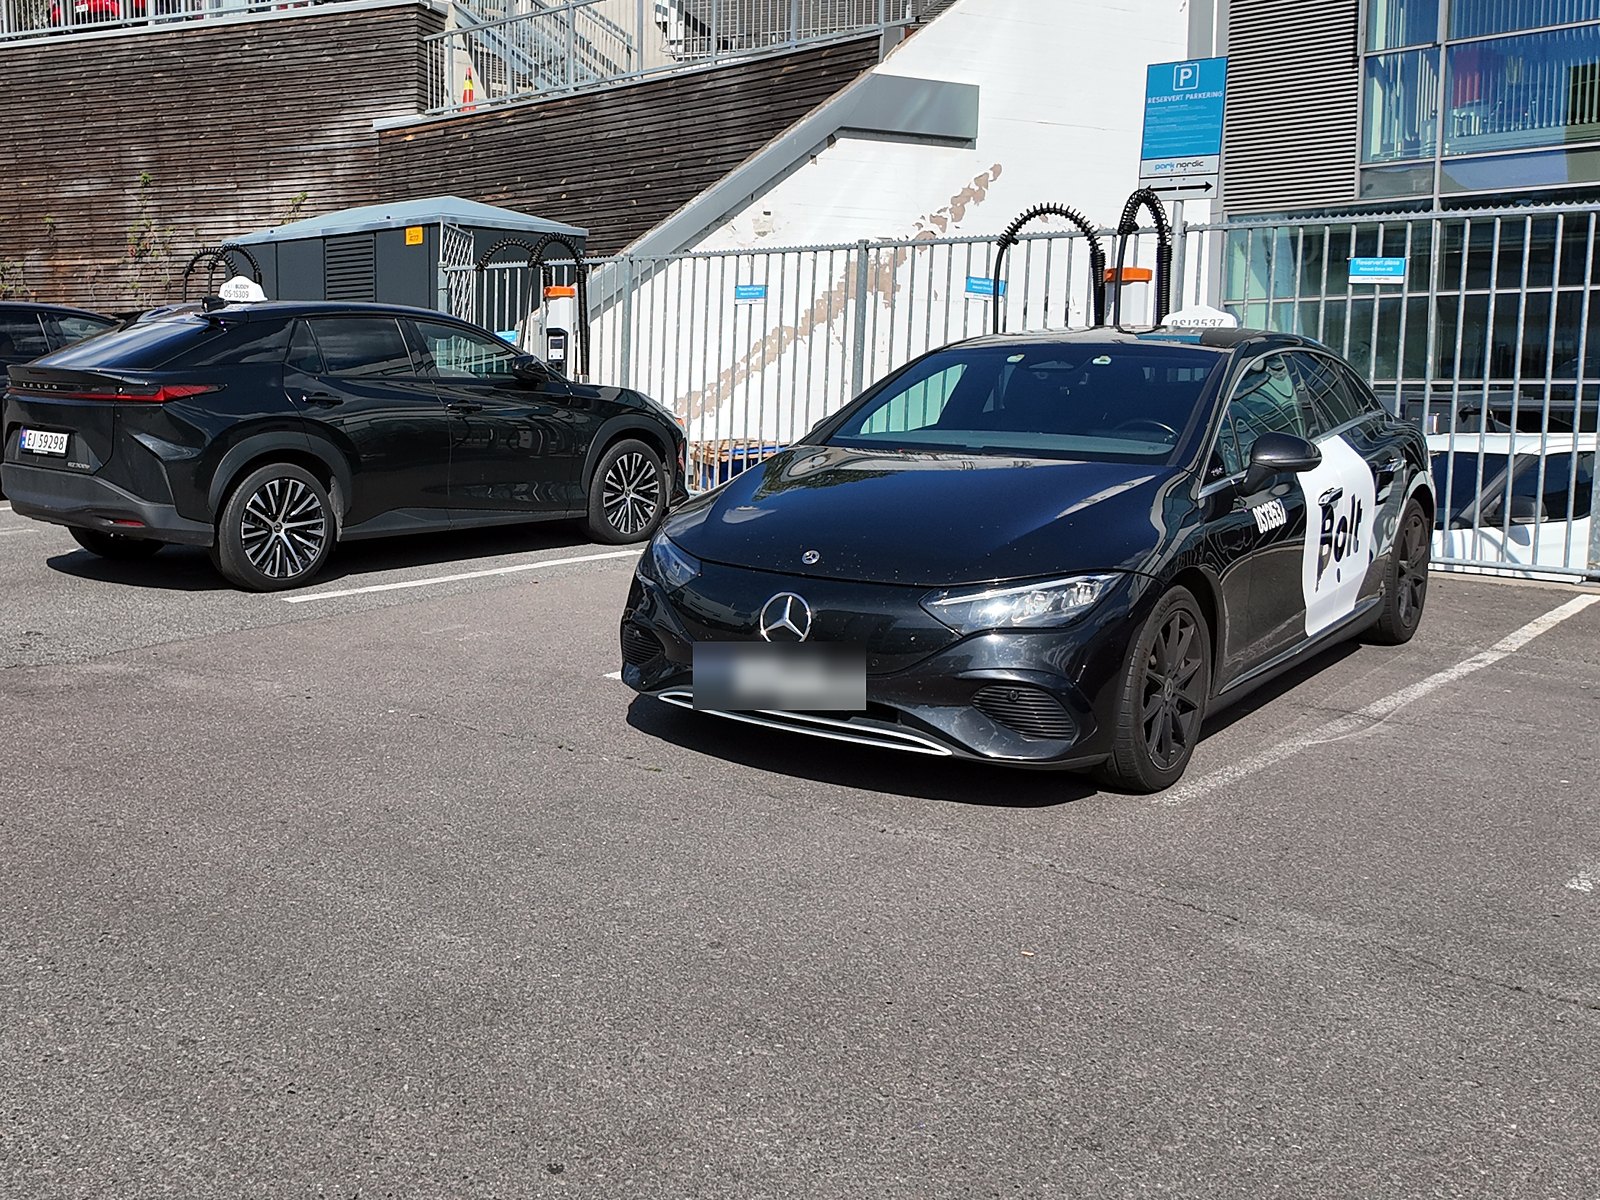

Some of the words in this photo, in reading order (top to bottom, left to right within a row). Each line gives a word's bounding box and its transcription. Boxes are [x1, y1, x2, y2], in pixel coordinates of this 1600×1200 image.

[1179, 68, 1193, 87] P
[1147, 94, 1184, 104] RESERVERT
[1185, 91, 1224, 100] PARKERING
[1154, 161, 1175, 171] park
[1175, 159, 1204, 169] nordic
[27, 432, 37, 447] EJ
[38, 433, 65, 451] 59298
[1252, 498, 1287, 534] OS13537
[1315, 493, 1363, 593] Bolt
